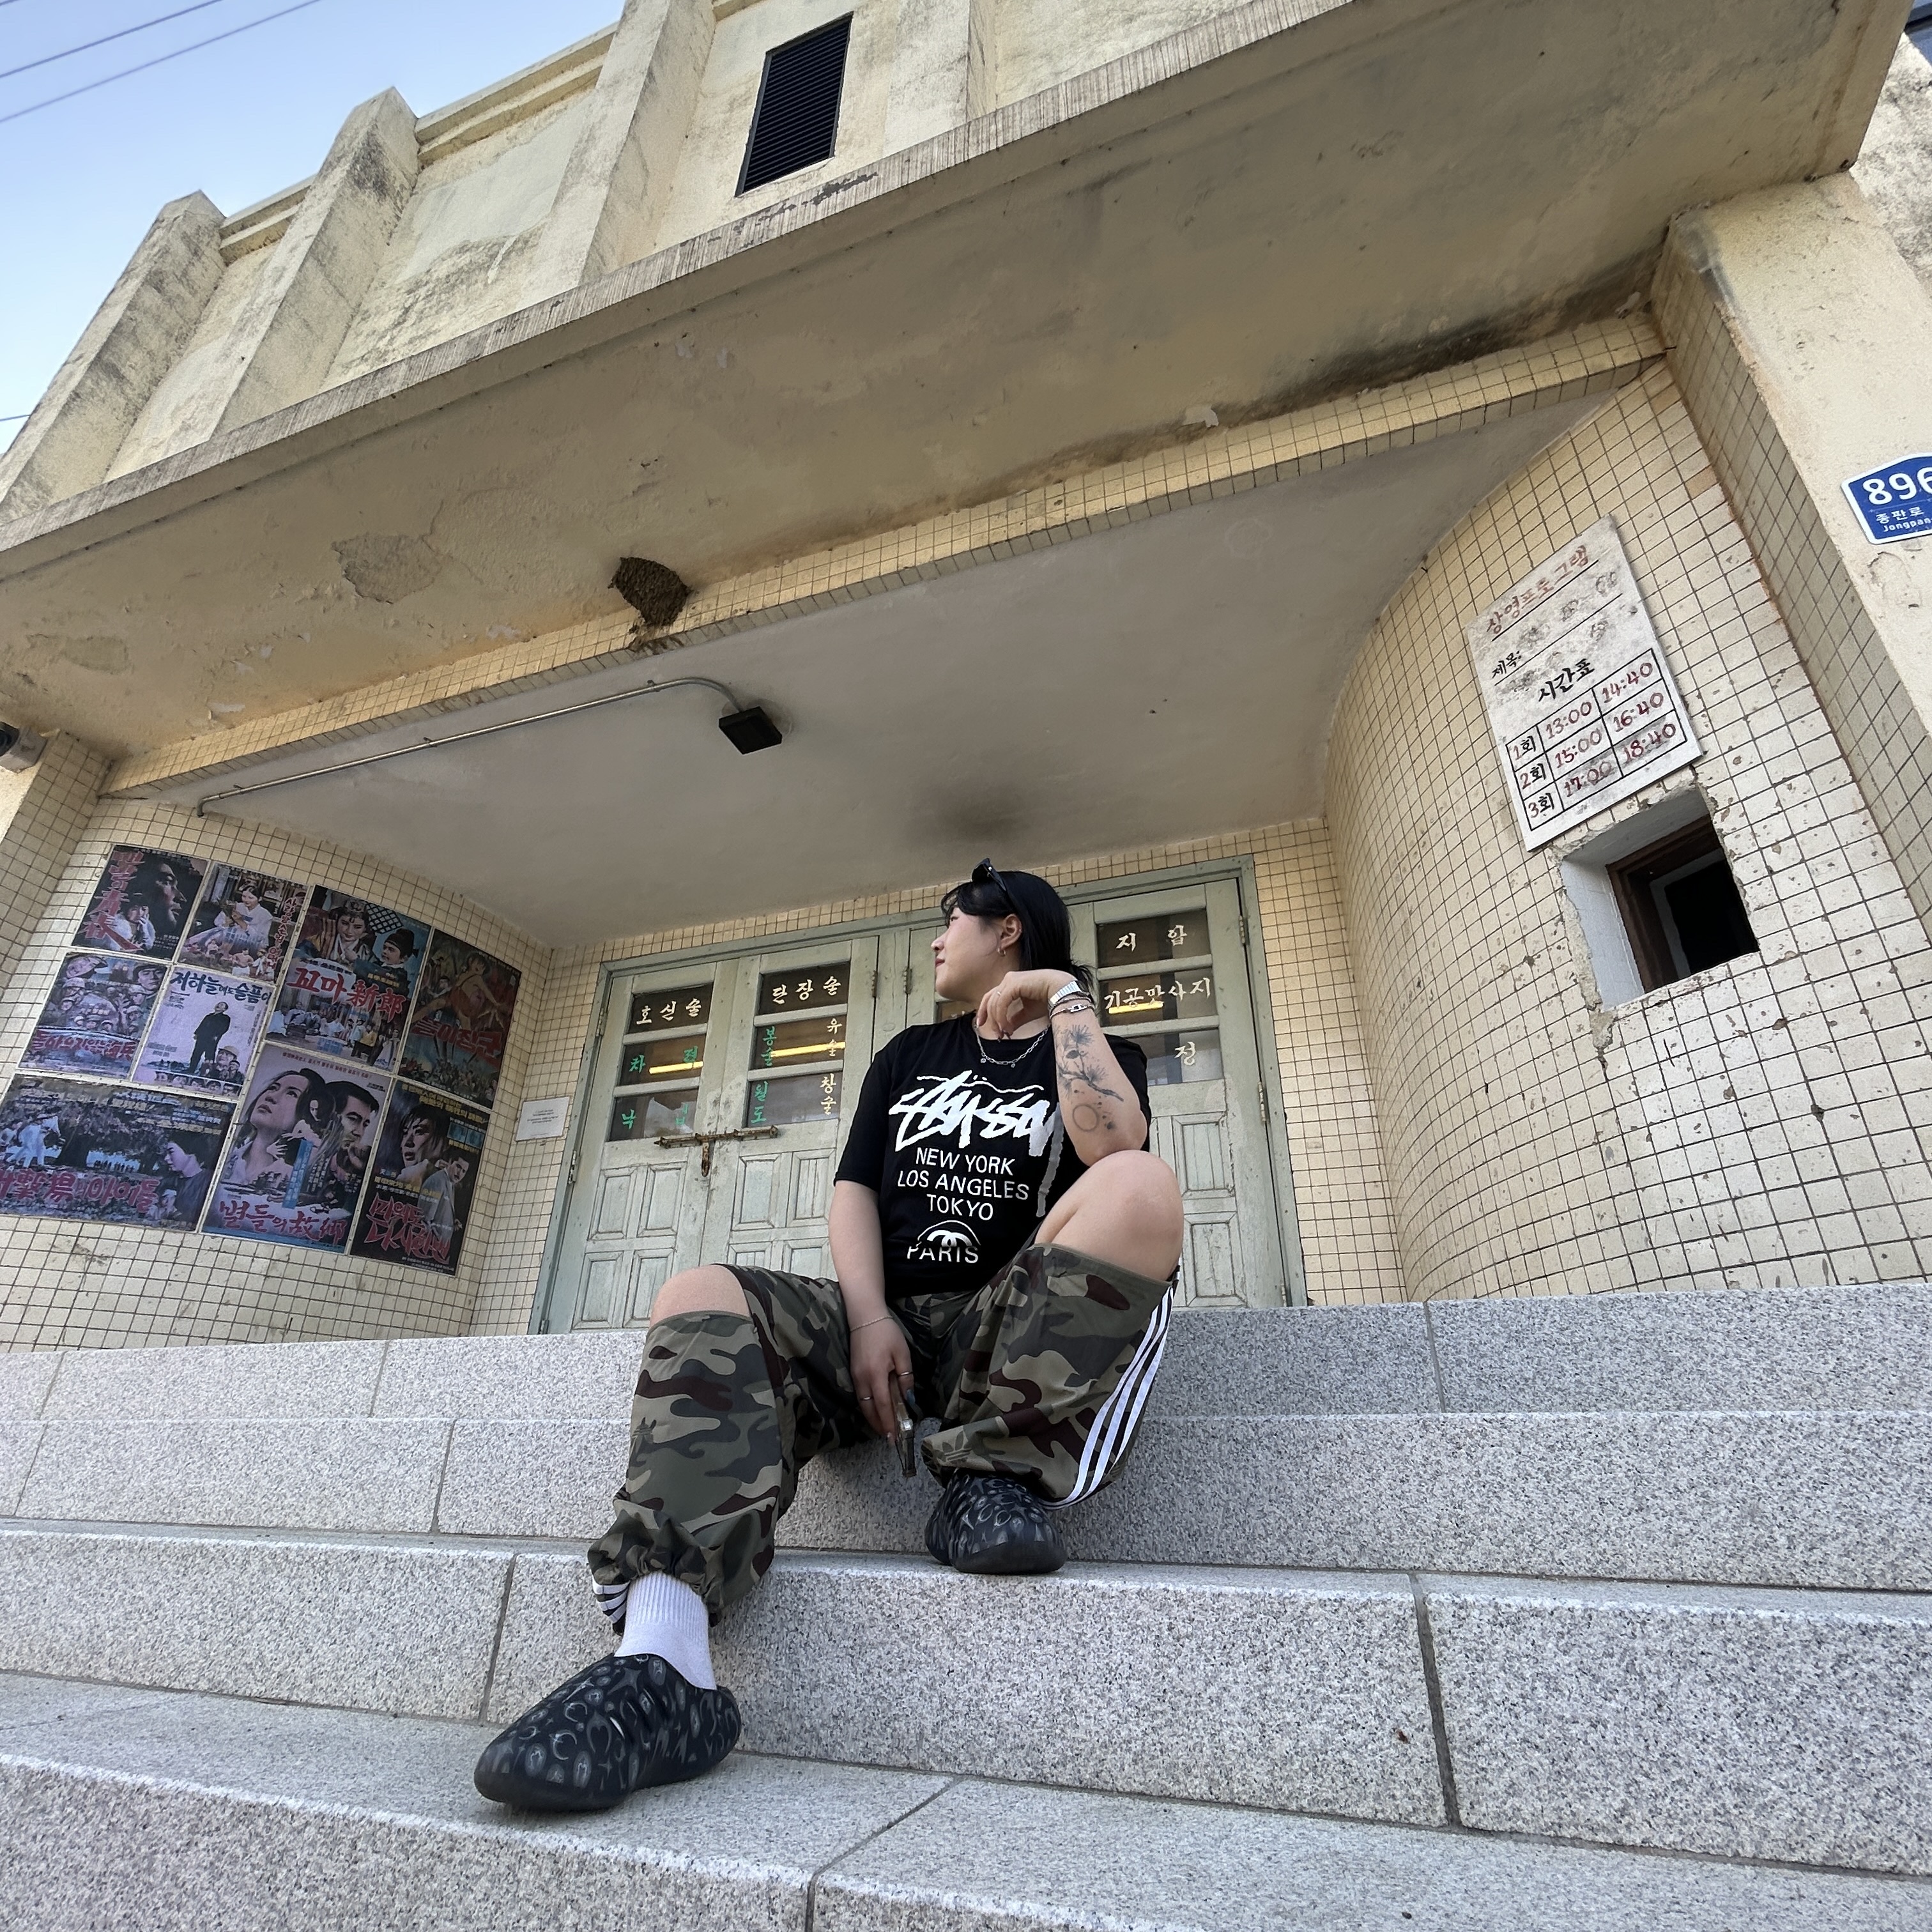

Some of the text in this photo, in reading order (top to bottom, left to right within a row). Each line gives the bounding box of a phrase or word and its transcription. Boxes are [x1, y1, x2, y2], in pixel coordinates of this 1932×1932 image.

[1862, 467, 1932, 505] 896
[1876, 507, 1924, 524] 종판로
[1487, 545, 1589, 634] 상영프로그램
[1491, 650, 1522, 678] 제목:
[1538, 659, 1595, 702] 시간표
[1513, 662, 1653, 760] 1회 13:00 14:40
[1520, 692, 1664, 790] 2회 15:00 16:40
[1528, 723, 1676, 818] 3회 17:00 18:40
[1116, 924, 1188, 951] 지압
[234, 983, 272, 1005] 슬픔이
[287, 966, 347, 1004] 꼬마
[772, 976, 841, 1004] 단장술
[636, 998, 702, 1025] 호신술
[820, 1073, 837, 1115] 창술
[916, 1147, 1015, 1176] NEW YORK
[898, 1170, 1029, 1200] LOS ANGELES
[219, 1200, 287, 1233] 별들의
[926, 1193, 993, 1220] TOKYO
[907, 1245, 979, 1263] PARIS
